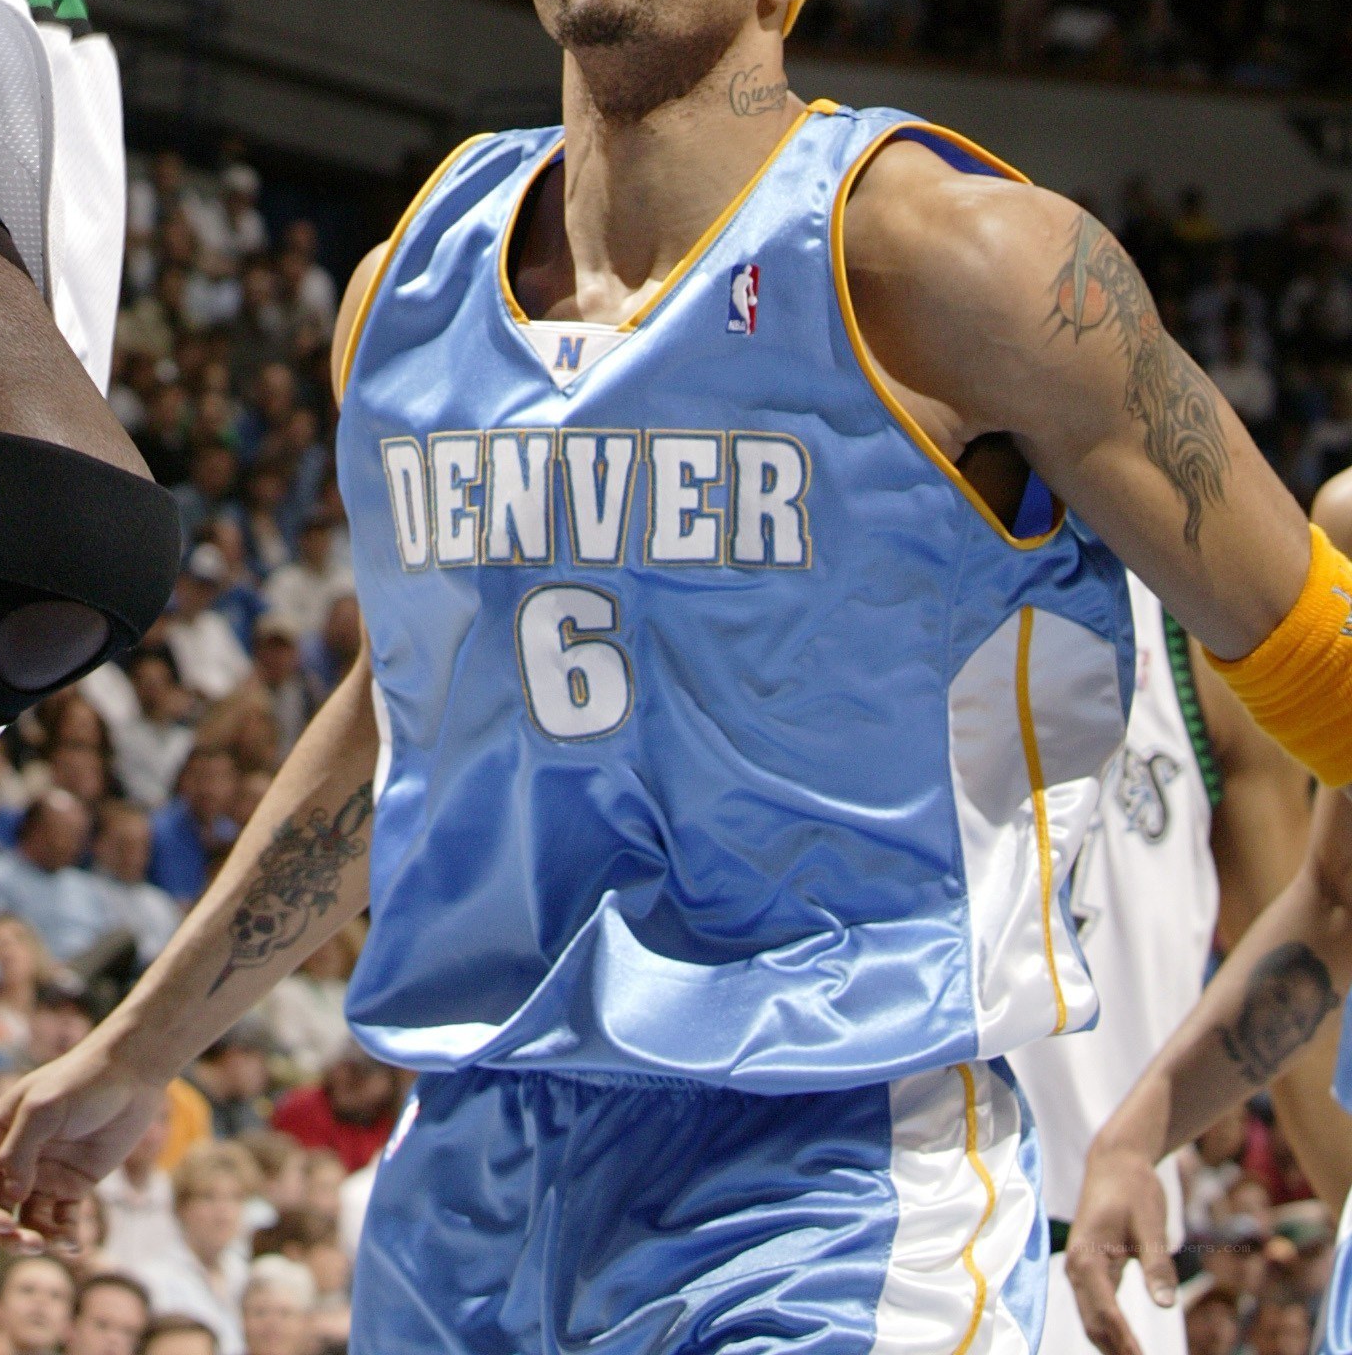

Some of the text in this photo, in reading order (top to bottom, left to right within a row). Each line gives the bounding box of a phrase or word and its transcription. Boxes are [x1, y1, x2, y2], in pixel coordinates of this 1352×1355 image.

[553, 333, 586, 372] N
[380, 426, 813, 572] DENVER
[514, 581, 635, 744] 6
